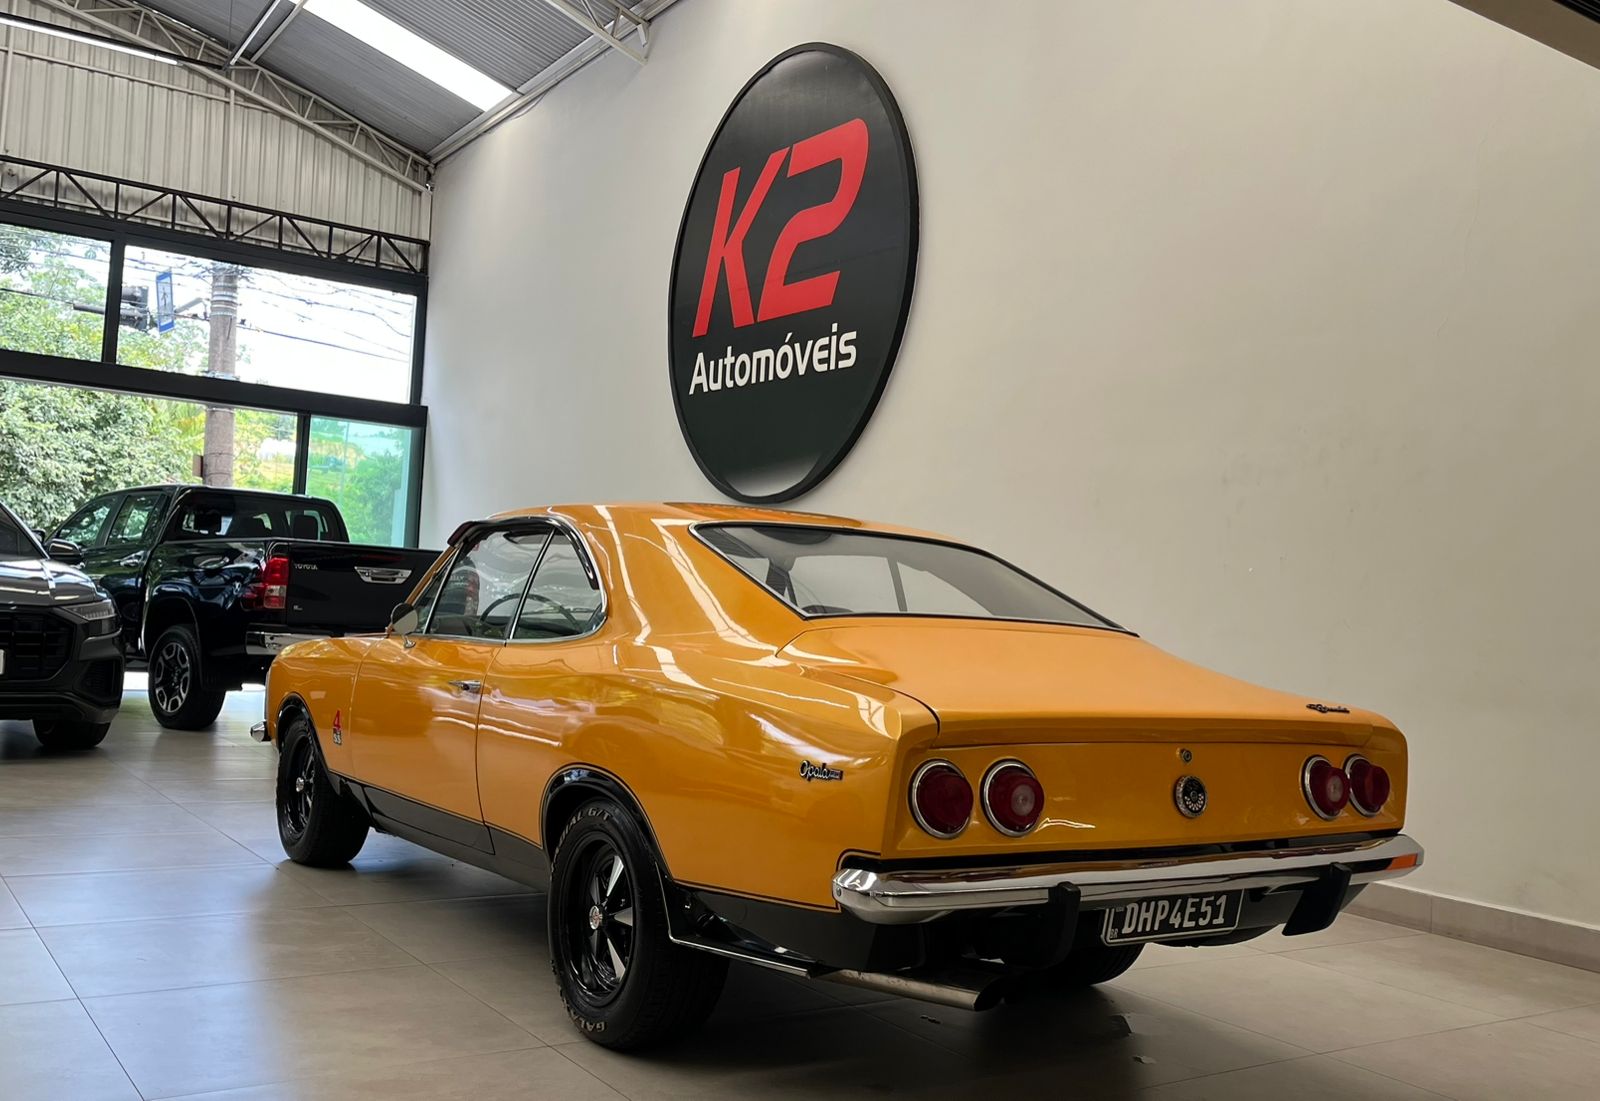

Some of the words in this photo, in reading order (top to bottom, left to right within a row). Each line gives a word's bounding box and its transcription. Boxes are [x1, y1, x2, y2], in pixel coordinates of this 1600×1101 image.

[692, 117, 869, 338] K2
[688, 322, 857, 396] Automóveis
[1121, 894, 1227, 934] DHP4E51
